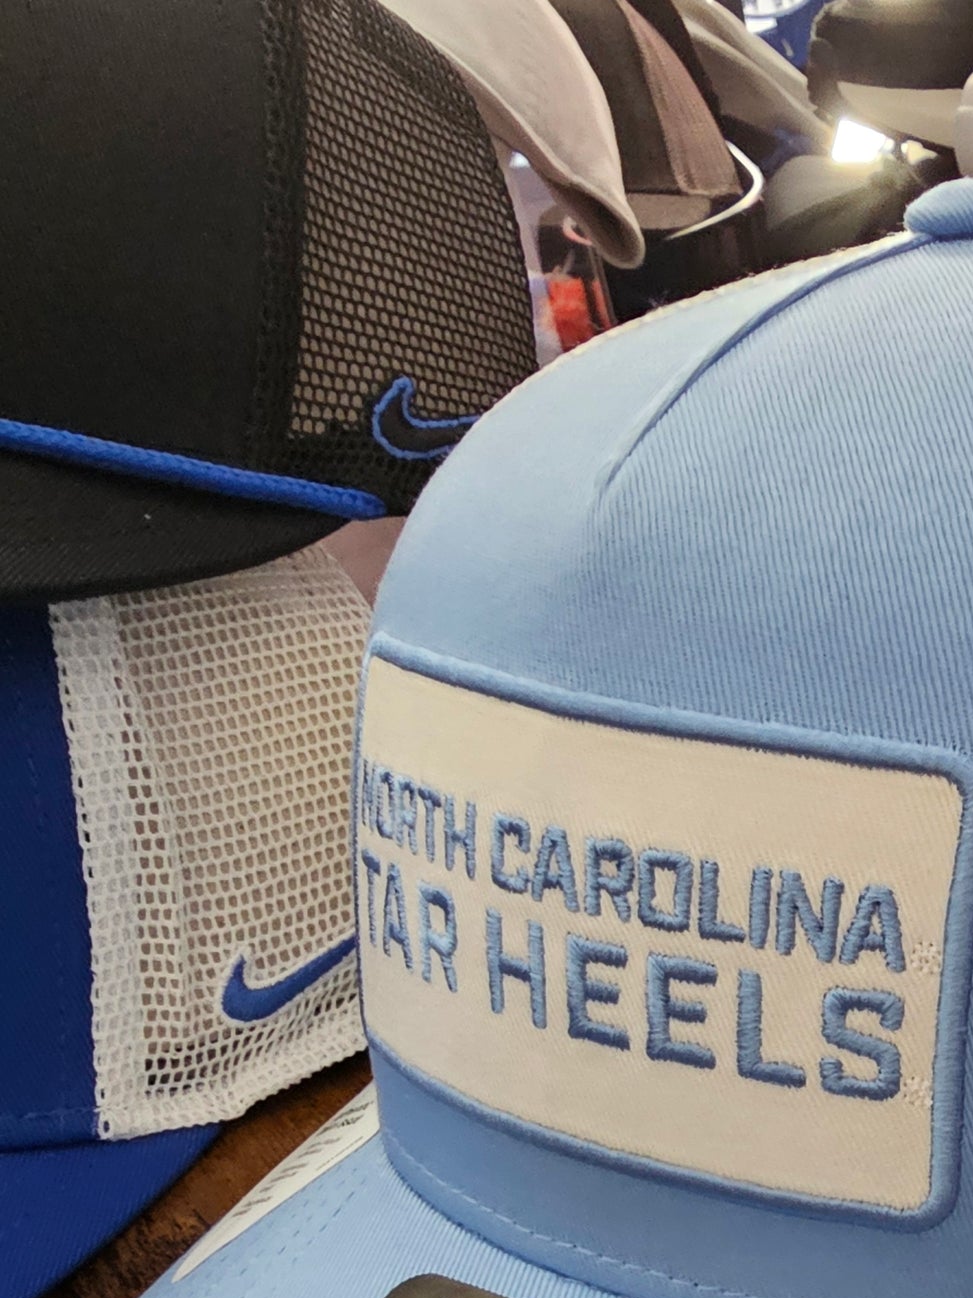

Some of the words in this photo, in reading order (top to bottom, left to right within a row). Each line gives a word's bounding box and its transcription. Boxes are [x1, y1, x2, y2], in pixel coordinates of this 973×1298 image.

[361, 847, 458, 994] TAR
[485, 905, 906, 1103] HEELS
[362, 758, 477, 881] NORTH
[490, 810, 907, 973] CAROLINA
